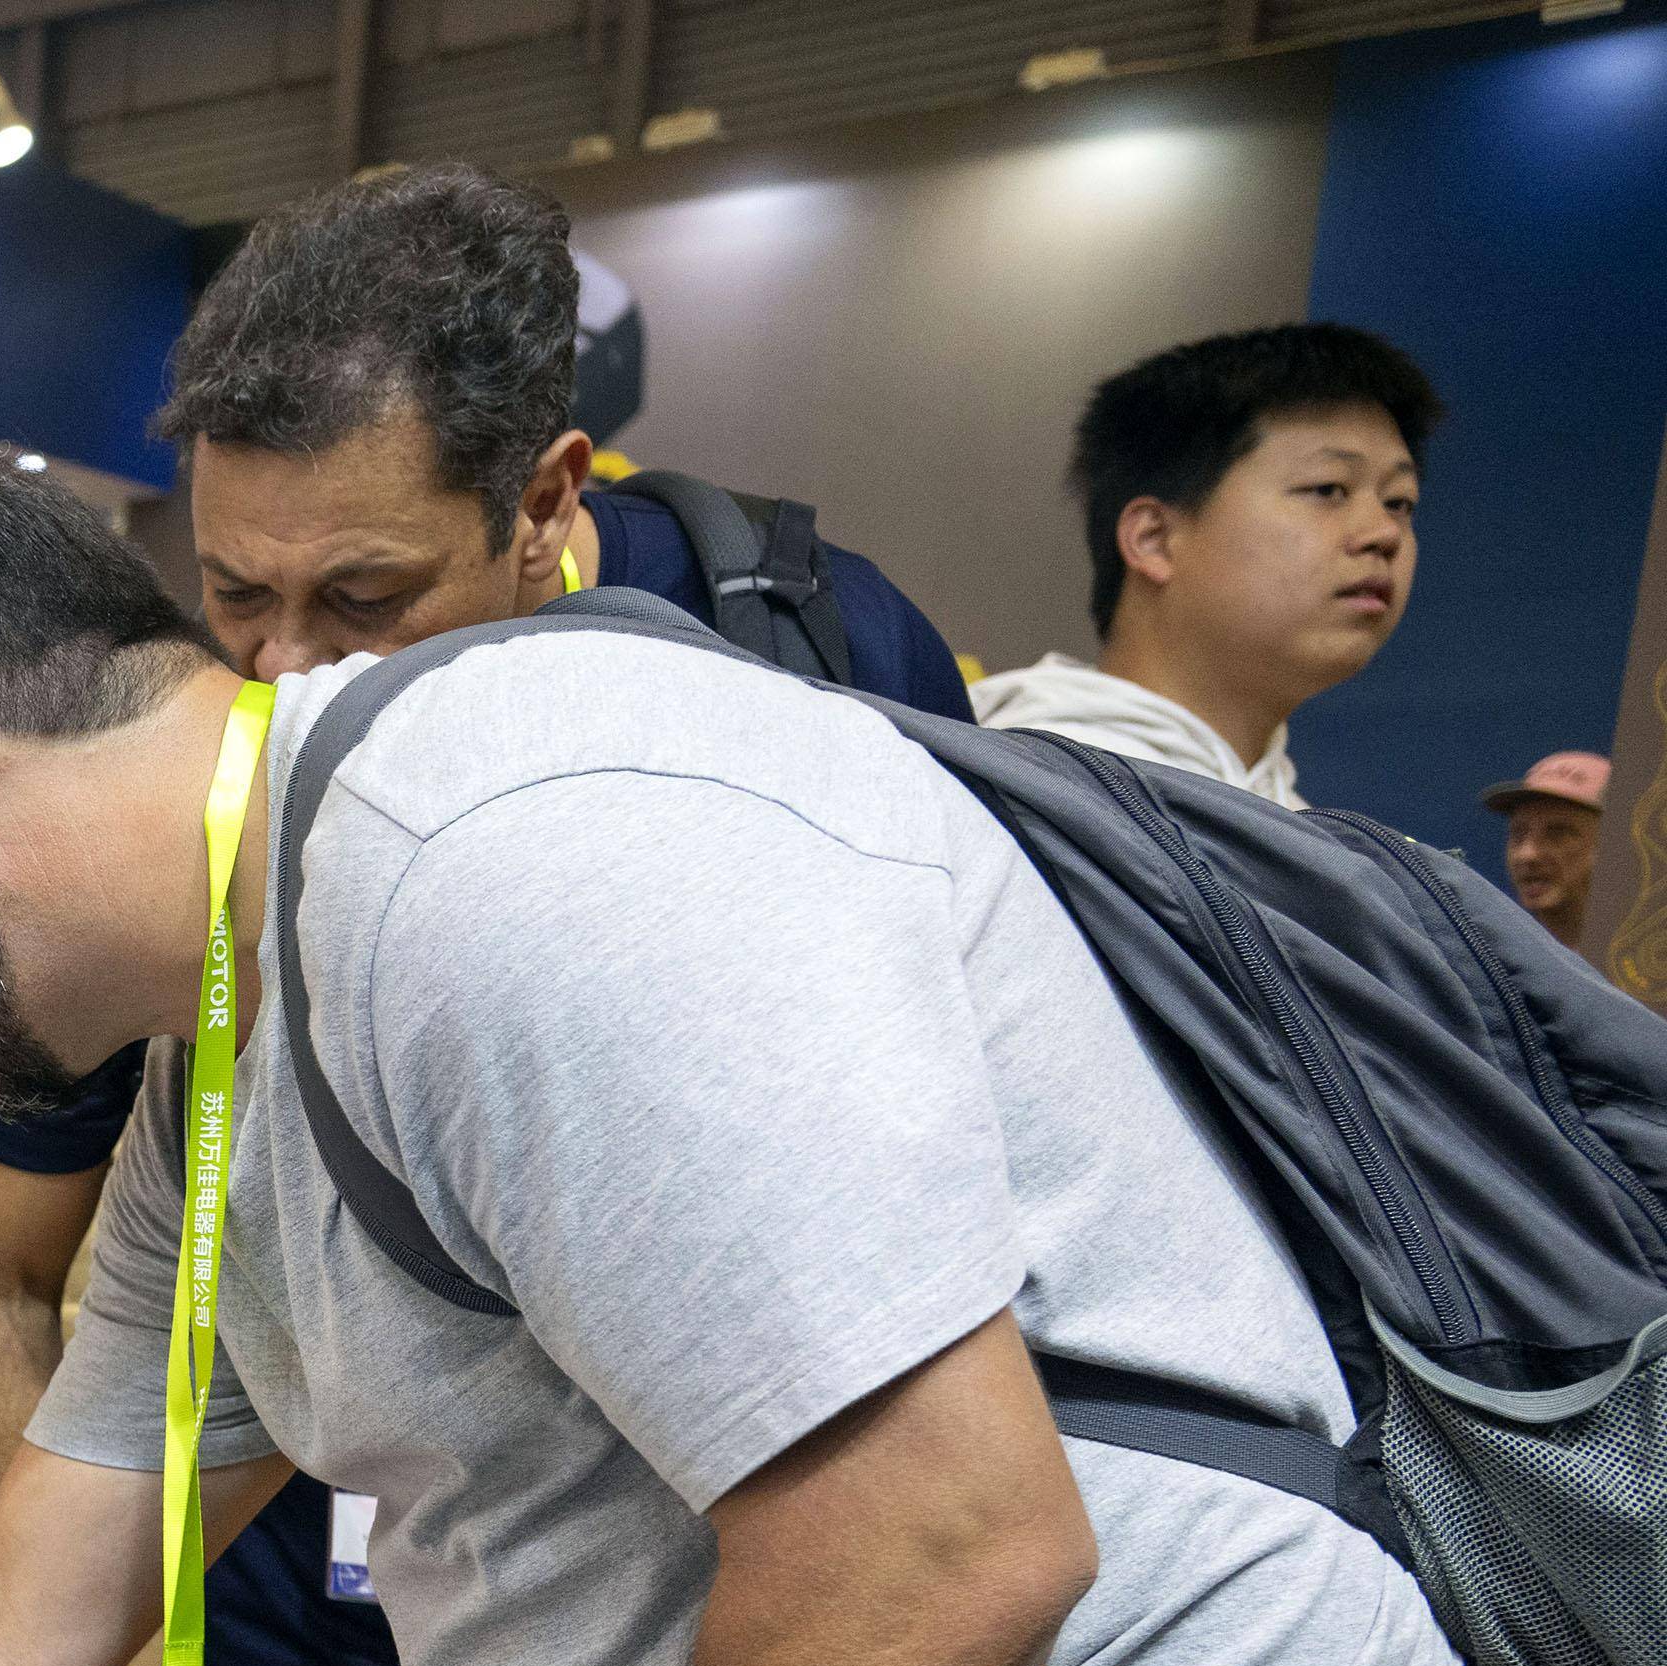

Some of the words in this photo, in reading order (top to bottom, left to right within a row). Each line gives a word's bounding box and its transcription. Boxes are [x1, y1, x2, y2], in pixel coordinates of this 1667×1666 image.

[194, 1091, 225, 1328] 苏州万佳电器有限公司
